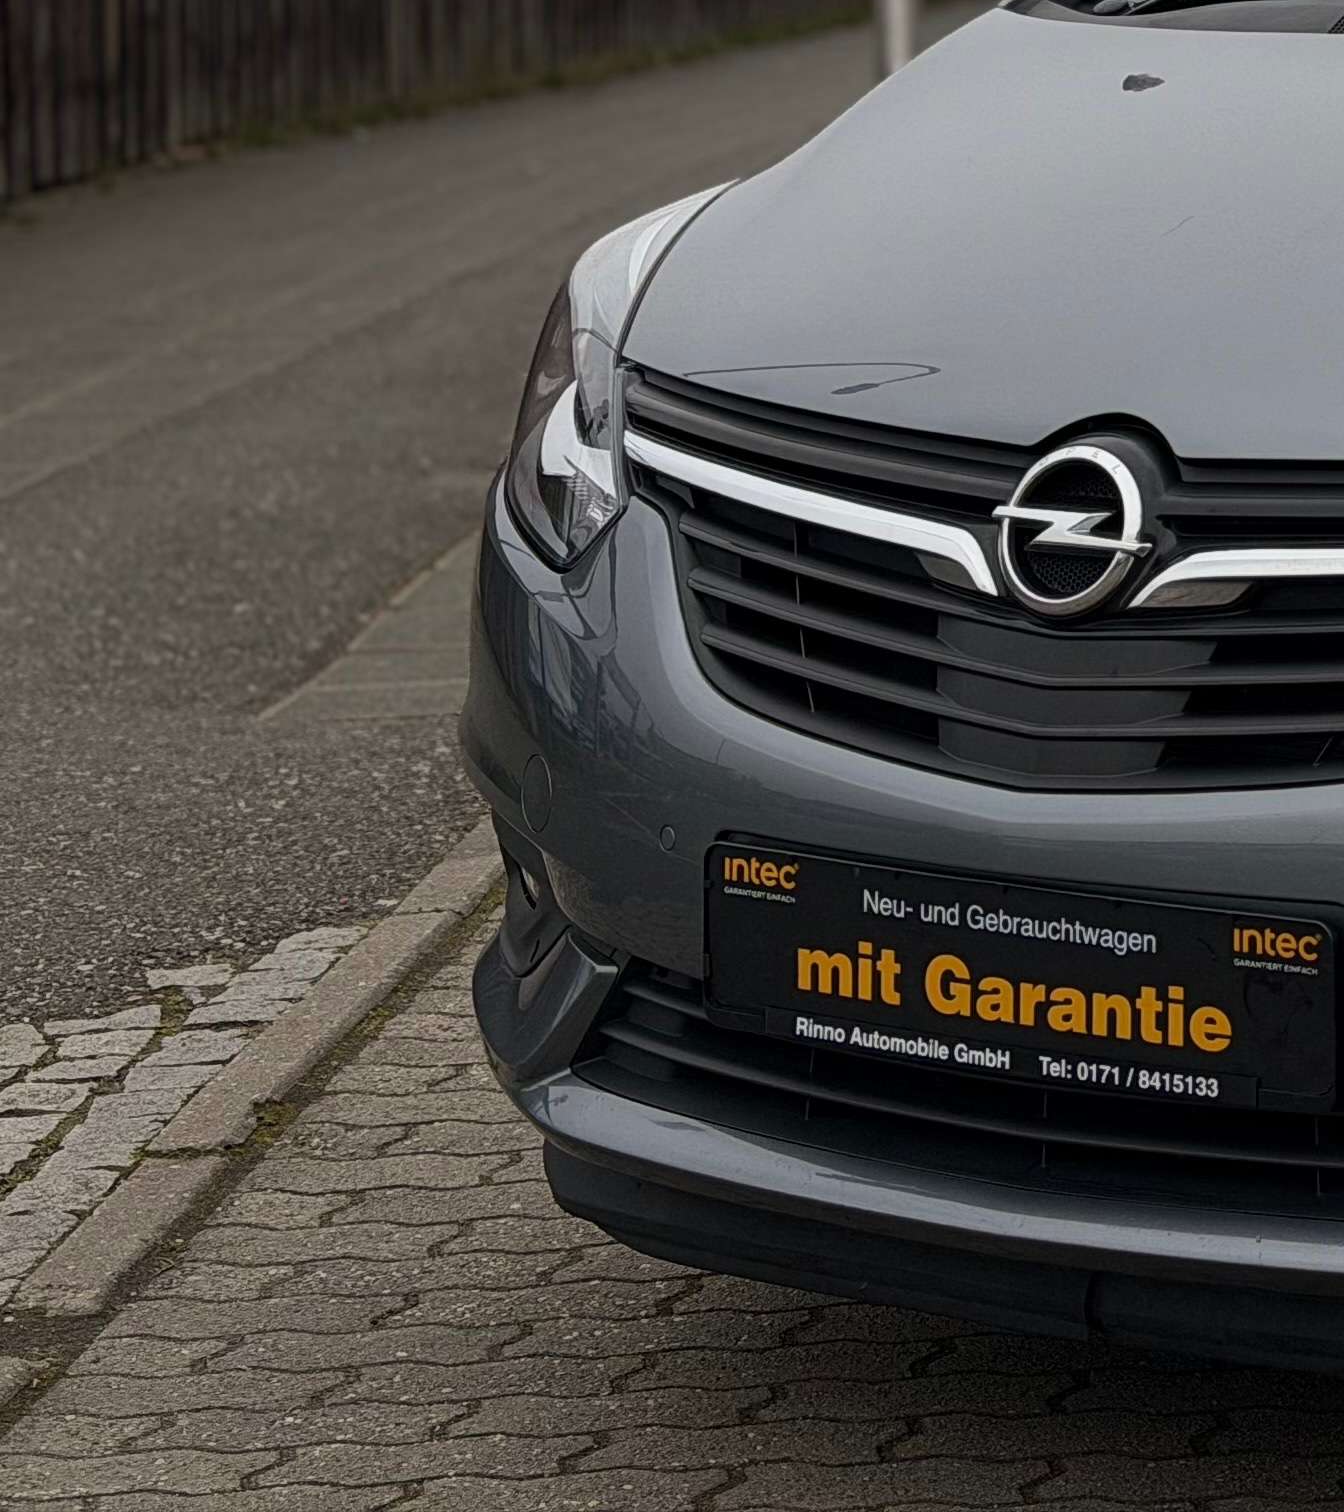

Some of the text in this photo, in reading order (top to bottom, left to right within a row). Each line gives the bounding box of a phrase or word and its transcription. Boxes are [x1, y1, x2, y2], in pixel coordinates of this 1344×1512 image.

[863, 889, 1157, 955] Neu- und Gebrauchtwagen
[797, 941, 1232, 1052] mit Garantie
[795, 1017, 1219, 1098] Rinno Automobile GmbH Tel: 0171 / 8415133
